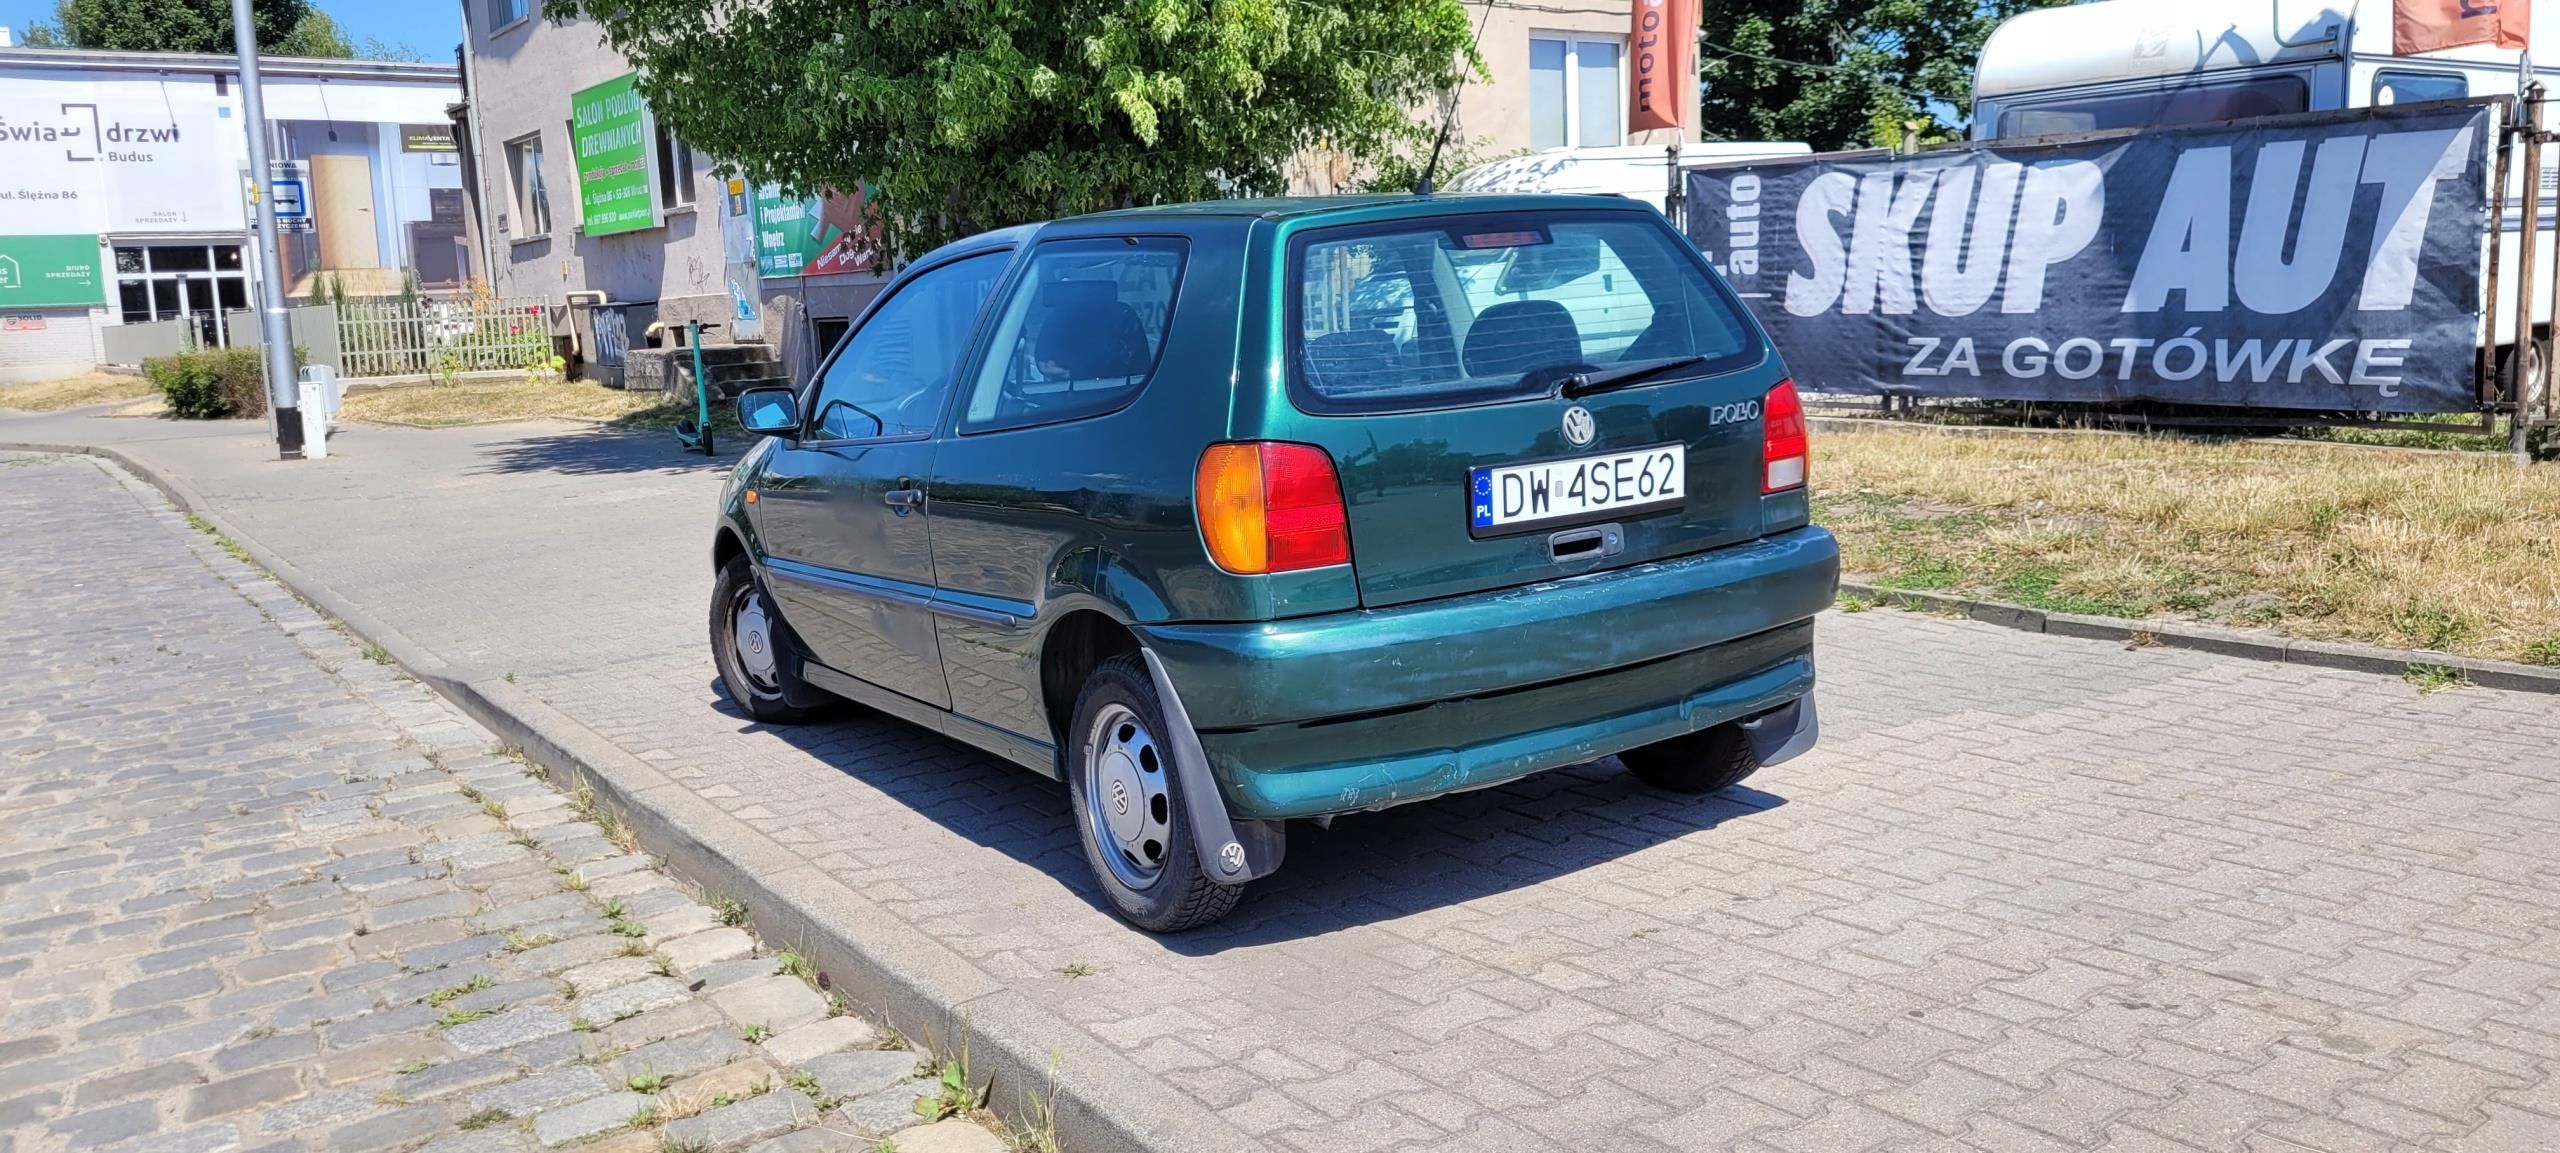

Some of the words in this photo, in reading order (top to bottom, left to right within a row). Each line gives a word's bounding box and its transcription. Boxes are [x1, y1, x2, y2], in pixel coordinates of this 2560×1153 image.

[577, 100, 604, 128] SALON
[106, 122, 180, 143] drzwi
[582, 120, 642, 158] DREWNIANYCH
[108, 151, 153, 162] Budus
[62, 190, 78, 199] 86
[1726, 173, 1762, 276] auto
[1784, 160, 2105, 317] SKUP
[2120, 126, 2474, 315] AUT
[762, 230, 785, 251] Wnętrz
[1903, 336, 1982, 376] ZA
[2002, 327, 2413, 398] GOTÓWKĘ
[1710, 400, 1760, 425] POLO
[1477, 505, 1491, 518] PL
[1502, 468, 1550, 519] DW
[1568, 452, 1675, 508] 4SE62
